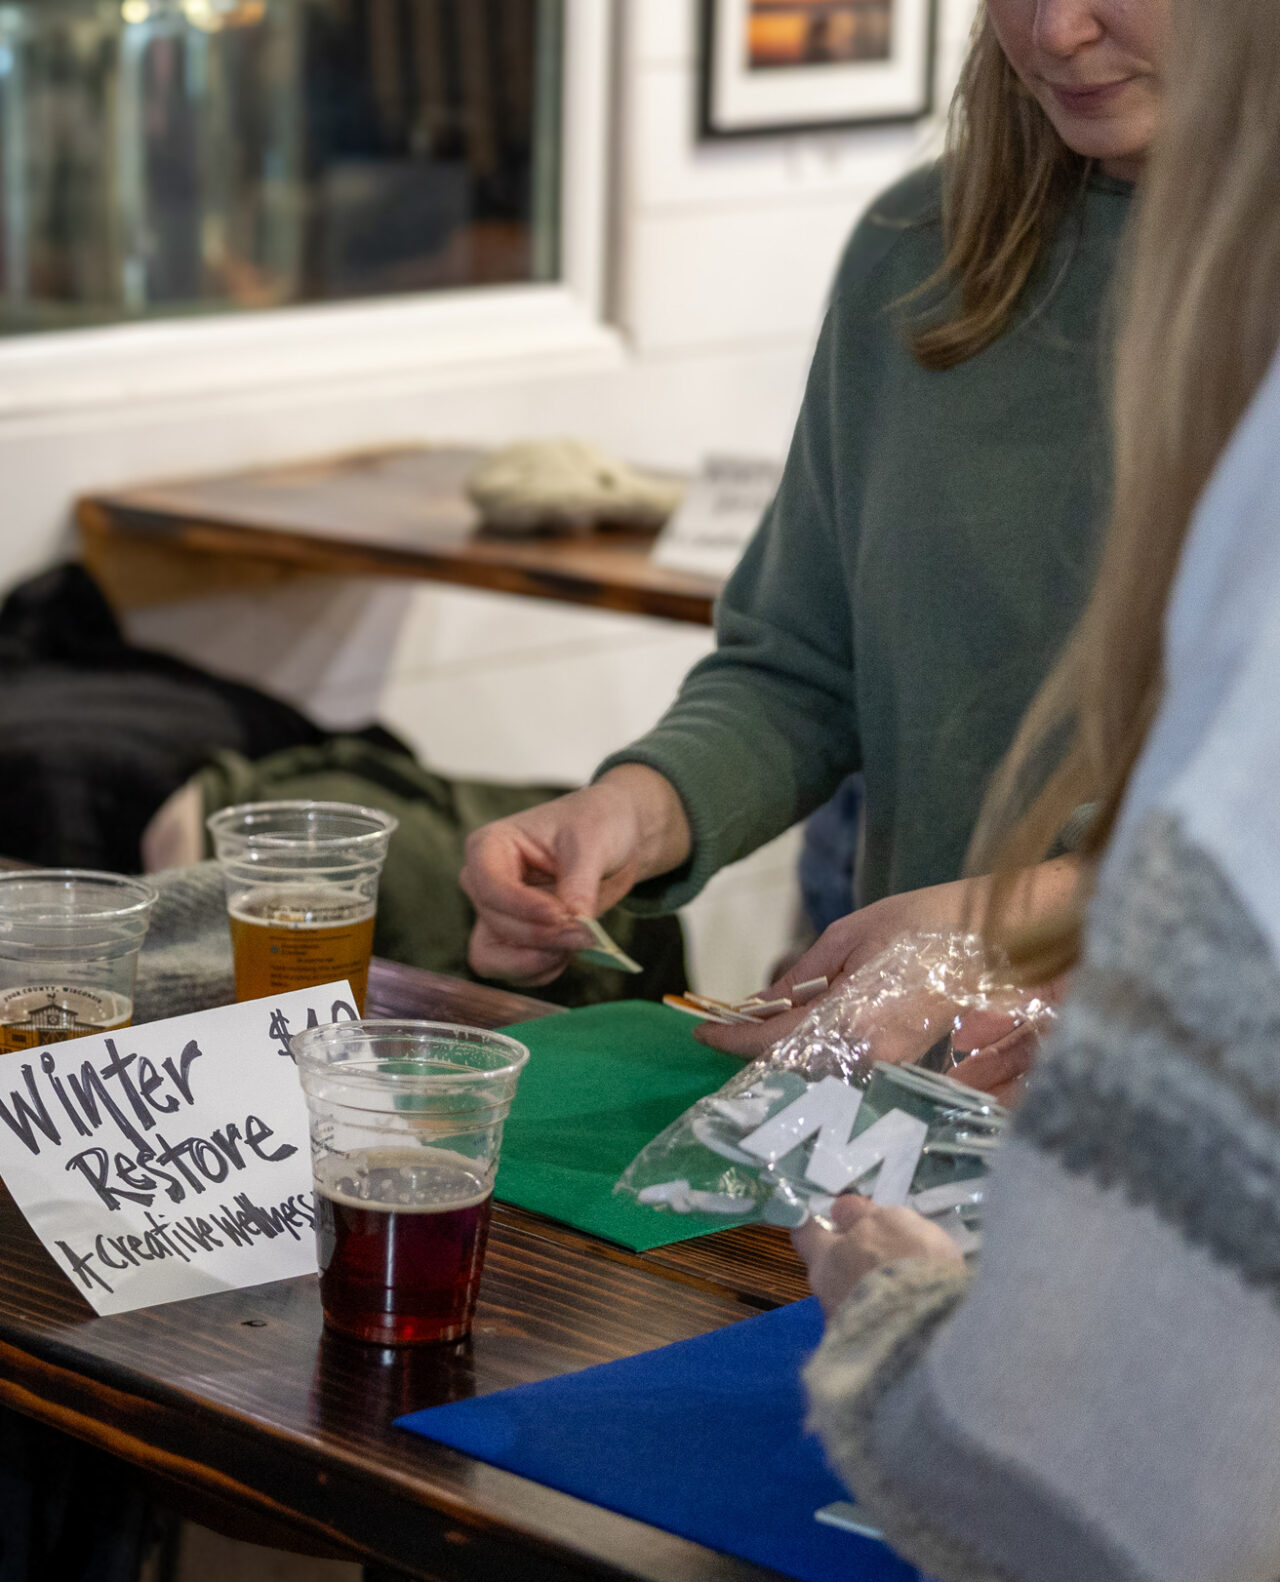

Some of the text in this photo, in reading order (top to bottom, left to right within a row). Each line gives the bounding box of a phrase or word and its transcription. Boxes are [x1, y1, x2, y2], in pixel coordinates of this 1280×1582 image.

[22, 985, 60, 995] COUNTY,
[62, 986, 103, 1004] WISCONSIN
[65, 1115, 299, 1212] Restore
[54, 1240, 114, 1294] A
